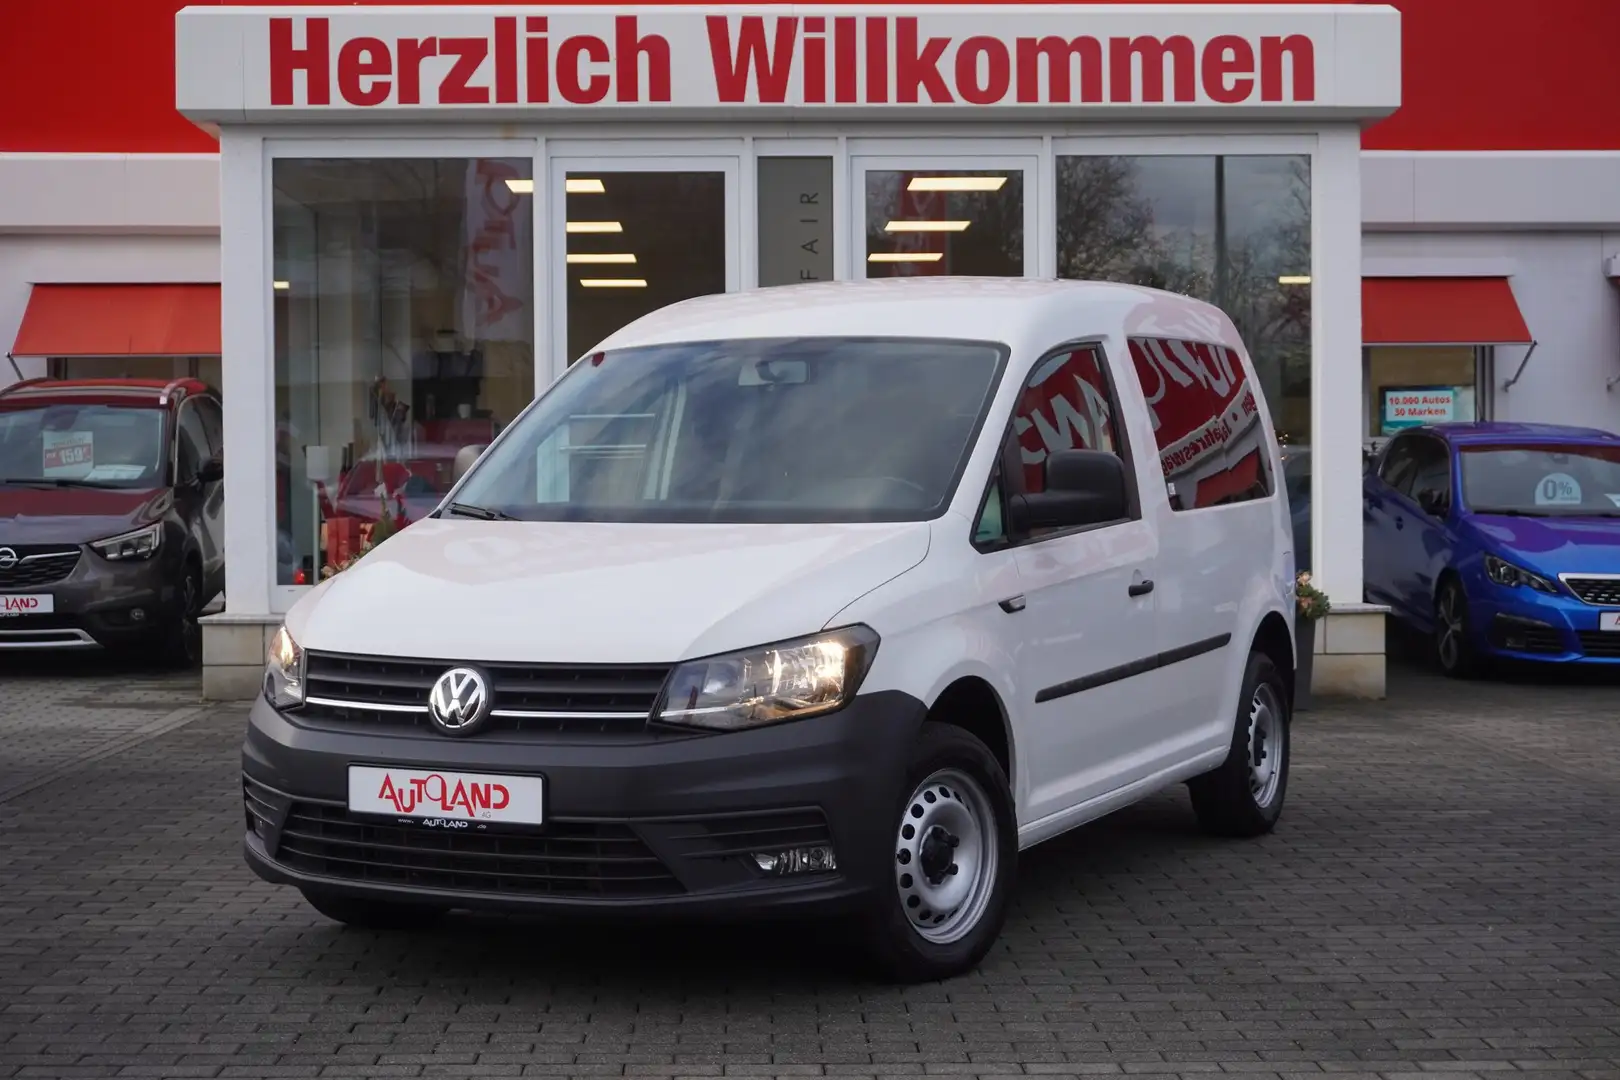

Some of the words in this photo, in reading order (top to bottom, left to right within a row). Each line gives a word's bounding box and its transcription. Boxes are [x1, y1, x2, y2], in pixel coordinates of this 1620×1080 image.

[269, 15, 671, 106] Herzlich
[705, 15, 1316, 105] Willkommen
[800, 192, 818, 280] FAIR
[1422, 396, 1451, 405] Autos
[1394, 407, 1406, 416] 30
[1408, 406, 1446, 416] Marken
[1543, 479, 1573, 500] 0%
[0, 596, 38, 612] LAND
[378, 772, 510, 818] AUTOLAND
[422, 817, 468, 829] AUTOLAND
